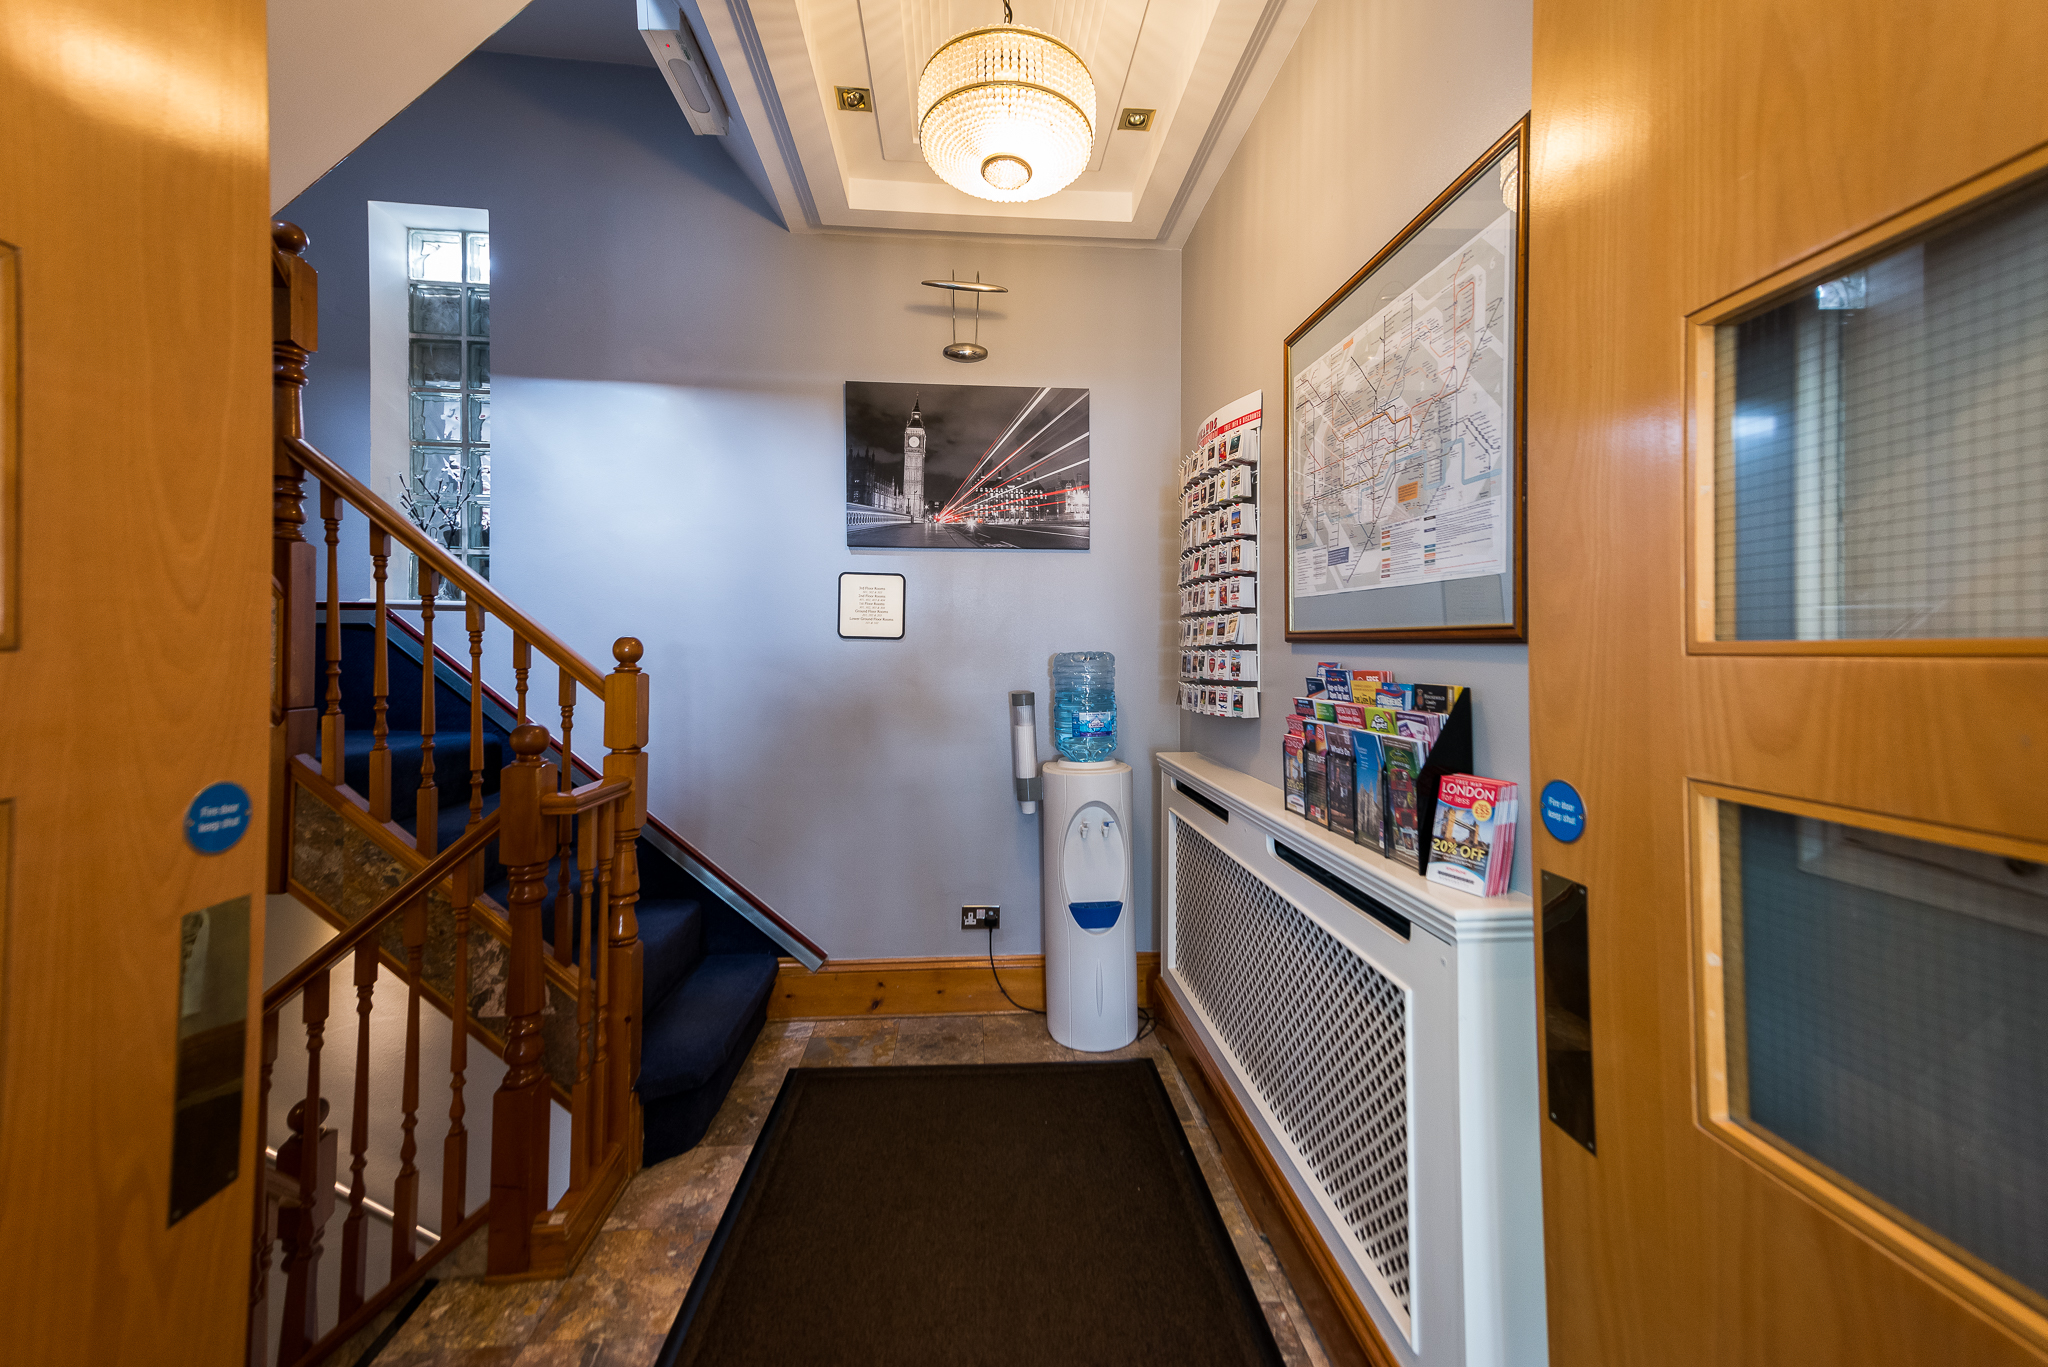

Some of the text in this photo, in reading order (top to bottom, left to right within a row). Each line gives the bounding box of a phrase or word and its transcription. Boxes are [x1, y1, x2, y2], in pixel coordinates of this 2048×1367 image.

[1371, 720, 1388, 731] Ape!
[1374, 715, 1385, 723] Go
[1441, 781, 1495, 802] LONDON
[1453, 794, 1470, 805] less
[200, 803, 240, 819] Fire door
[1548, 796, 1575, 812] Fire door
[197, 815, 241, 834] keep shut
[1547, 808, 1577, 826] keep shut
[1432, 838, 1458, 855] 20%
[1459, 845, 1486, 862] OFF
